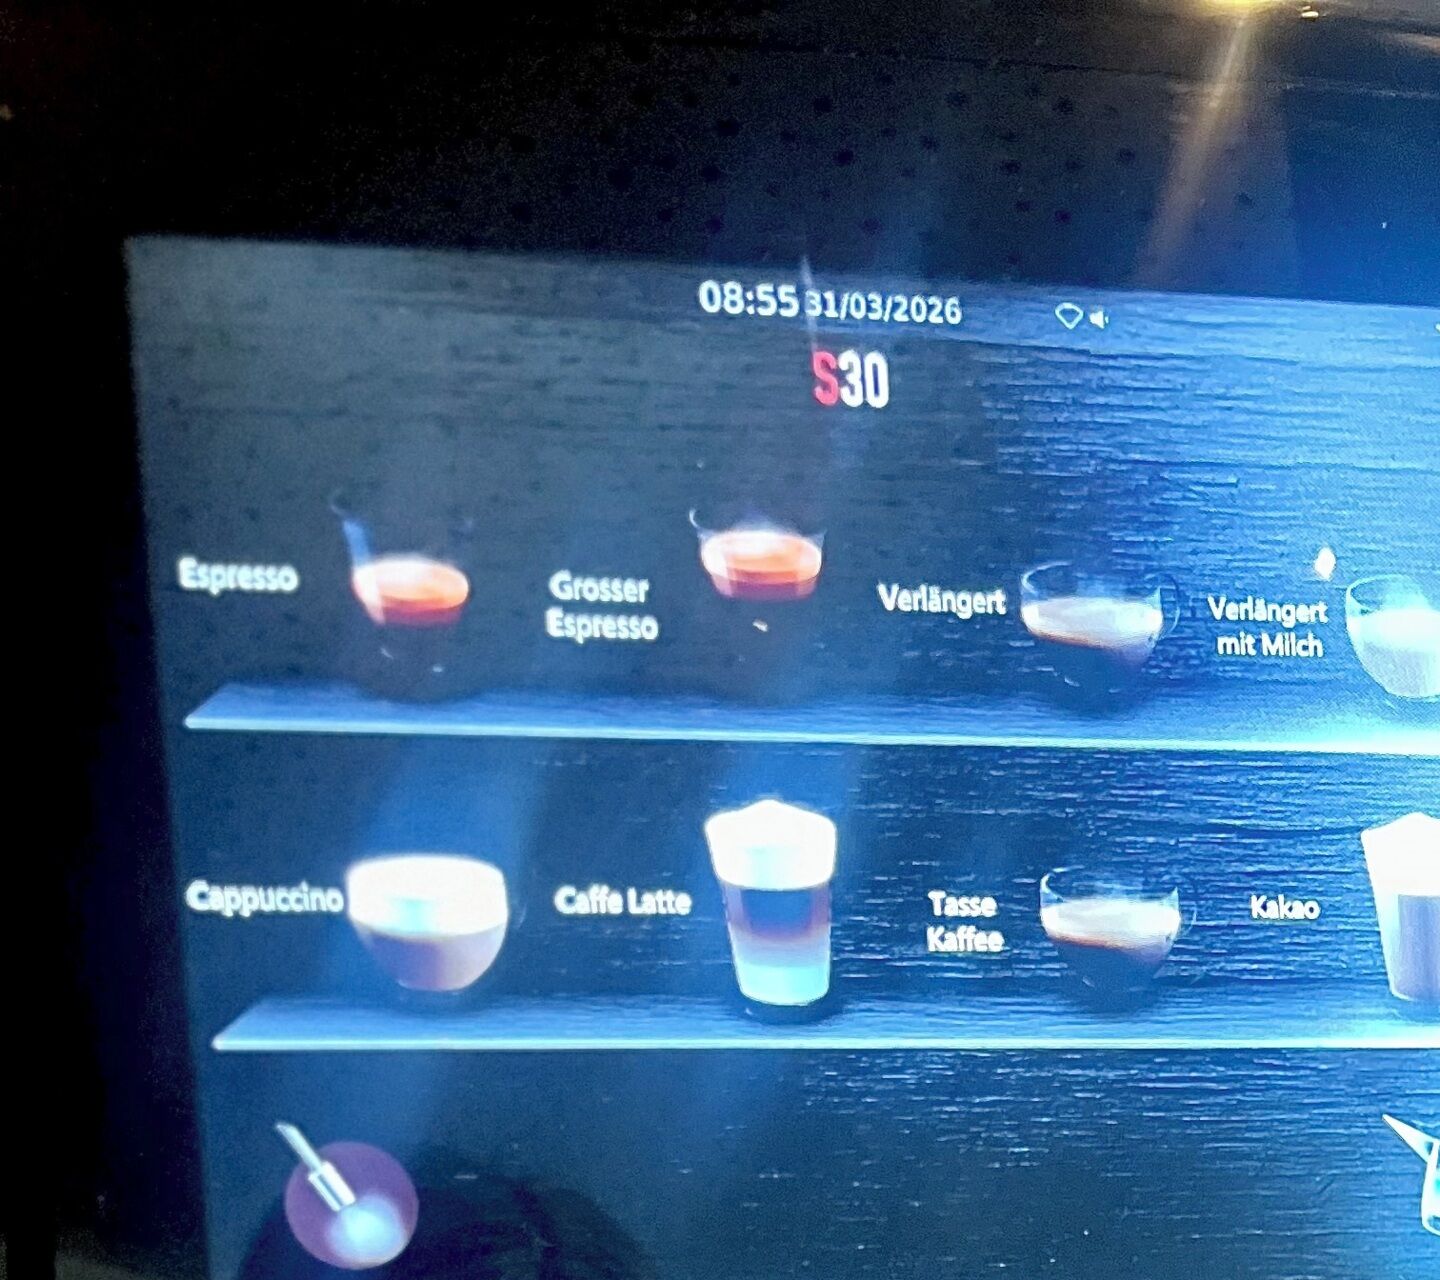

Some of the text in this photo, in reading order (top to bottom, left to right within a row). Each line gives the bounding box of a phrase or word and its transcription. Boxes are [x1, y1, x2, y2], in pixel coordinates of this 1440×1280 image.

[699, 281, 962, 325] 08:55 31/03/2026
[812, 351, 889, 408] S30
[178, 557, 299, 597] Espresso
[548, 571, 650, 604] Grosser
[877, 584, 1007, 619] Verlängert
[1207, 596, 1329, 628] Verlängert
[545, 608, 659, 644] Espresso
[1216, 632, 1324, 658] mit Milch
[186, 880, 344, 917] Cappuccino
[628, 888, 692, 917] Latte
[928, 890, 997, 919] Tasse
[1250, 895, 1321, 921] Kakao
[927, 925, 1005, 953] Kaffee
